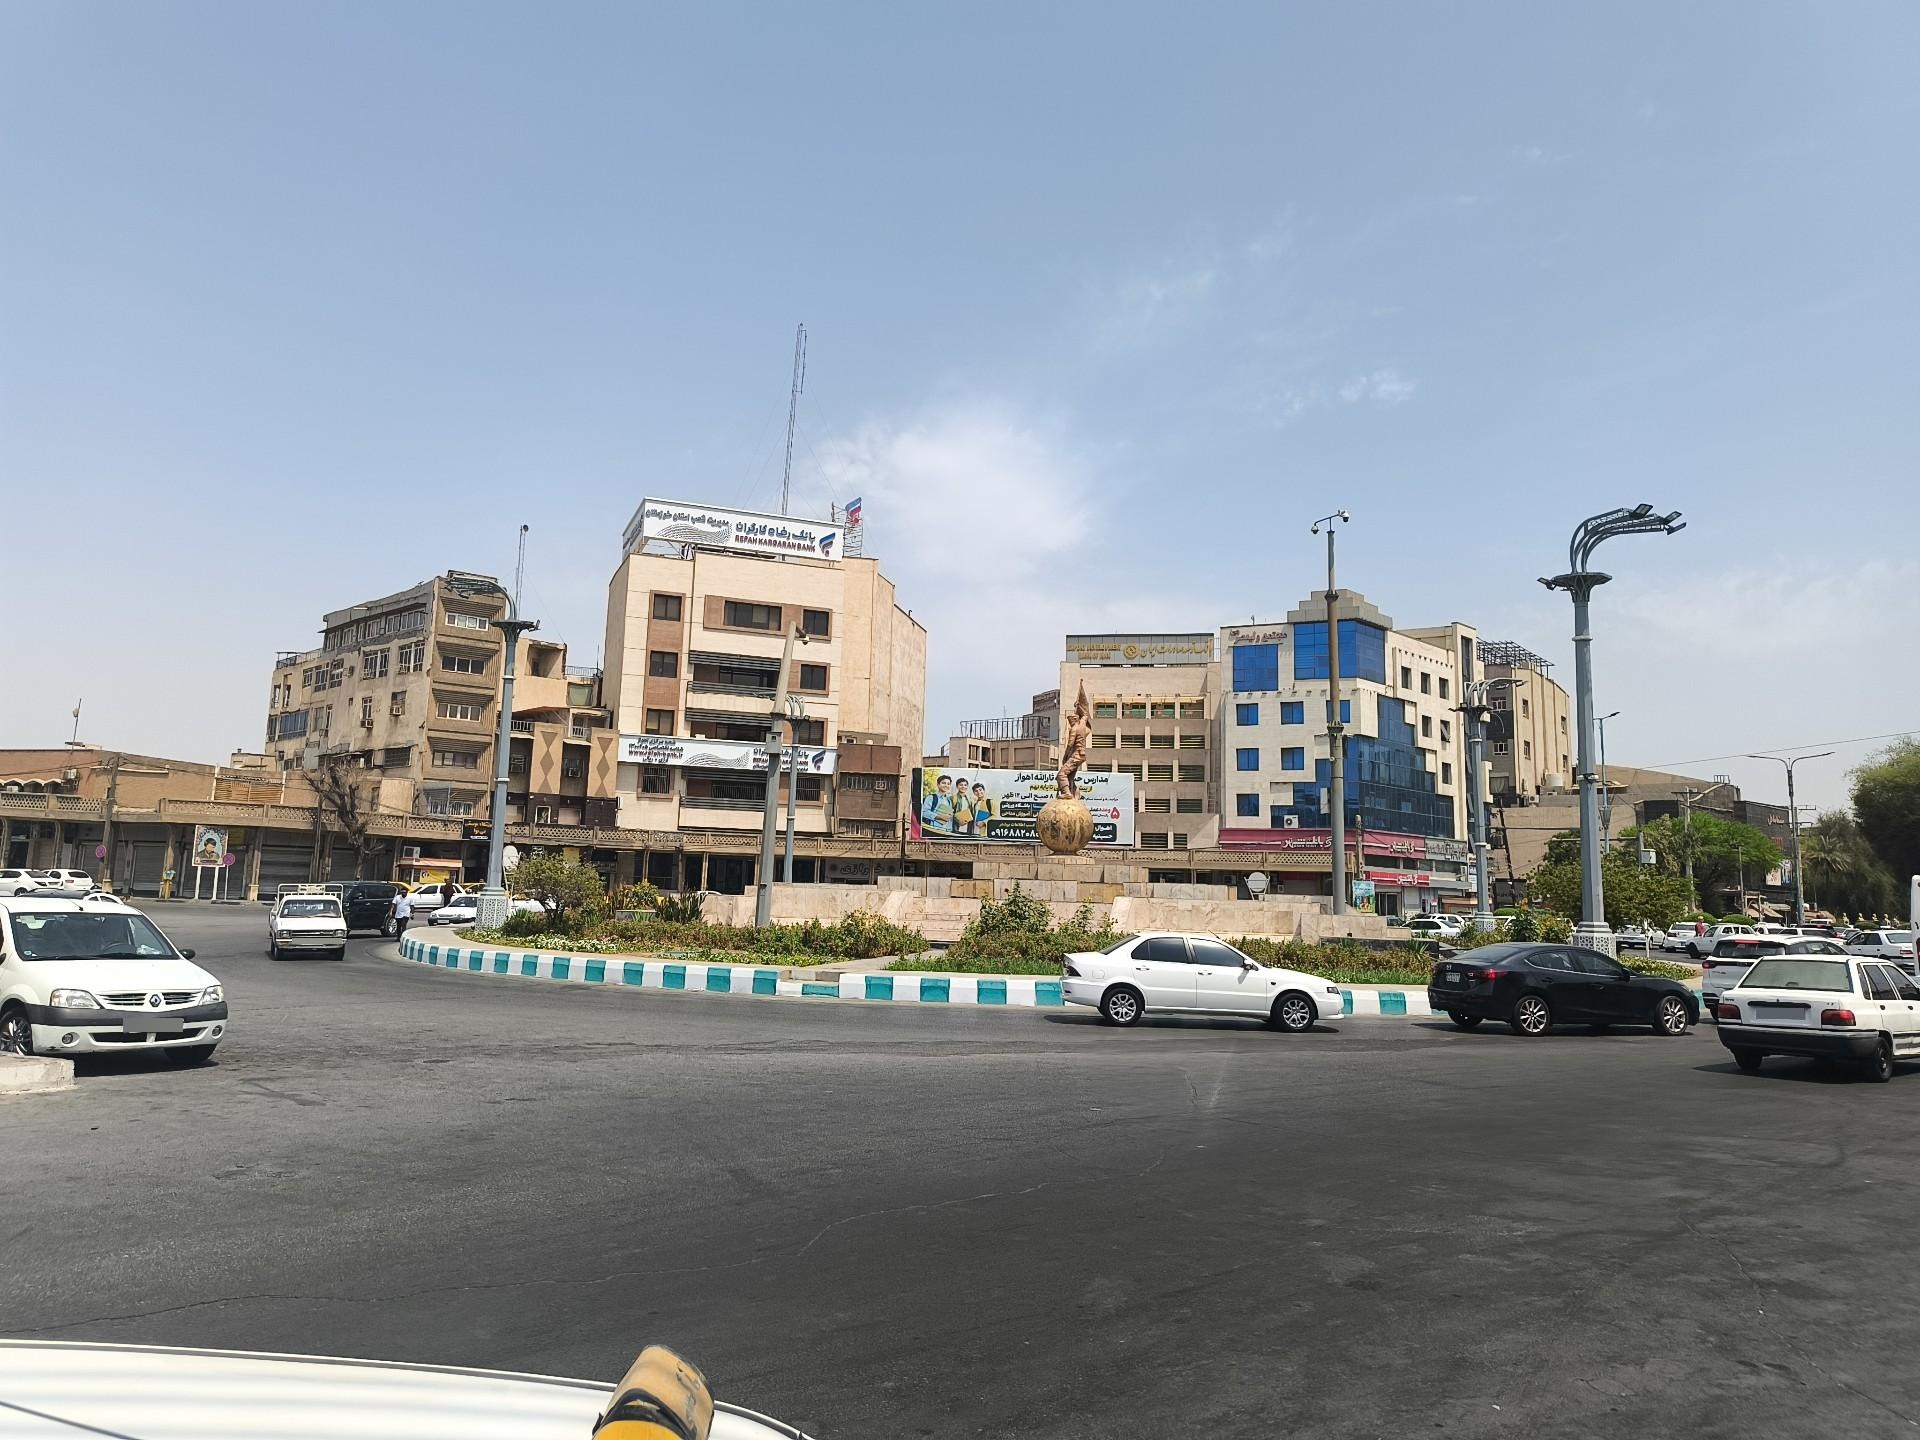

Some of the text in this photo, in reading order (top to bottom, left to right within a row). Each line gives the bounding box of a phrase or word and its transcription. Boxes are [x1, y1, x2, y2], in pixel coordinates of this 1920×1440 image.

[736, 521, 816, 543] بانک رفاه کارگران
[1014, 772, 1033, 782] اهواز
[1083, 775, 1108, 784] مدارس
[1033, 793, 1049, 801] صبح
